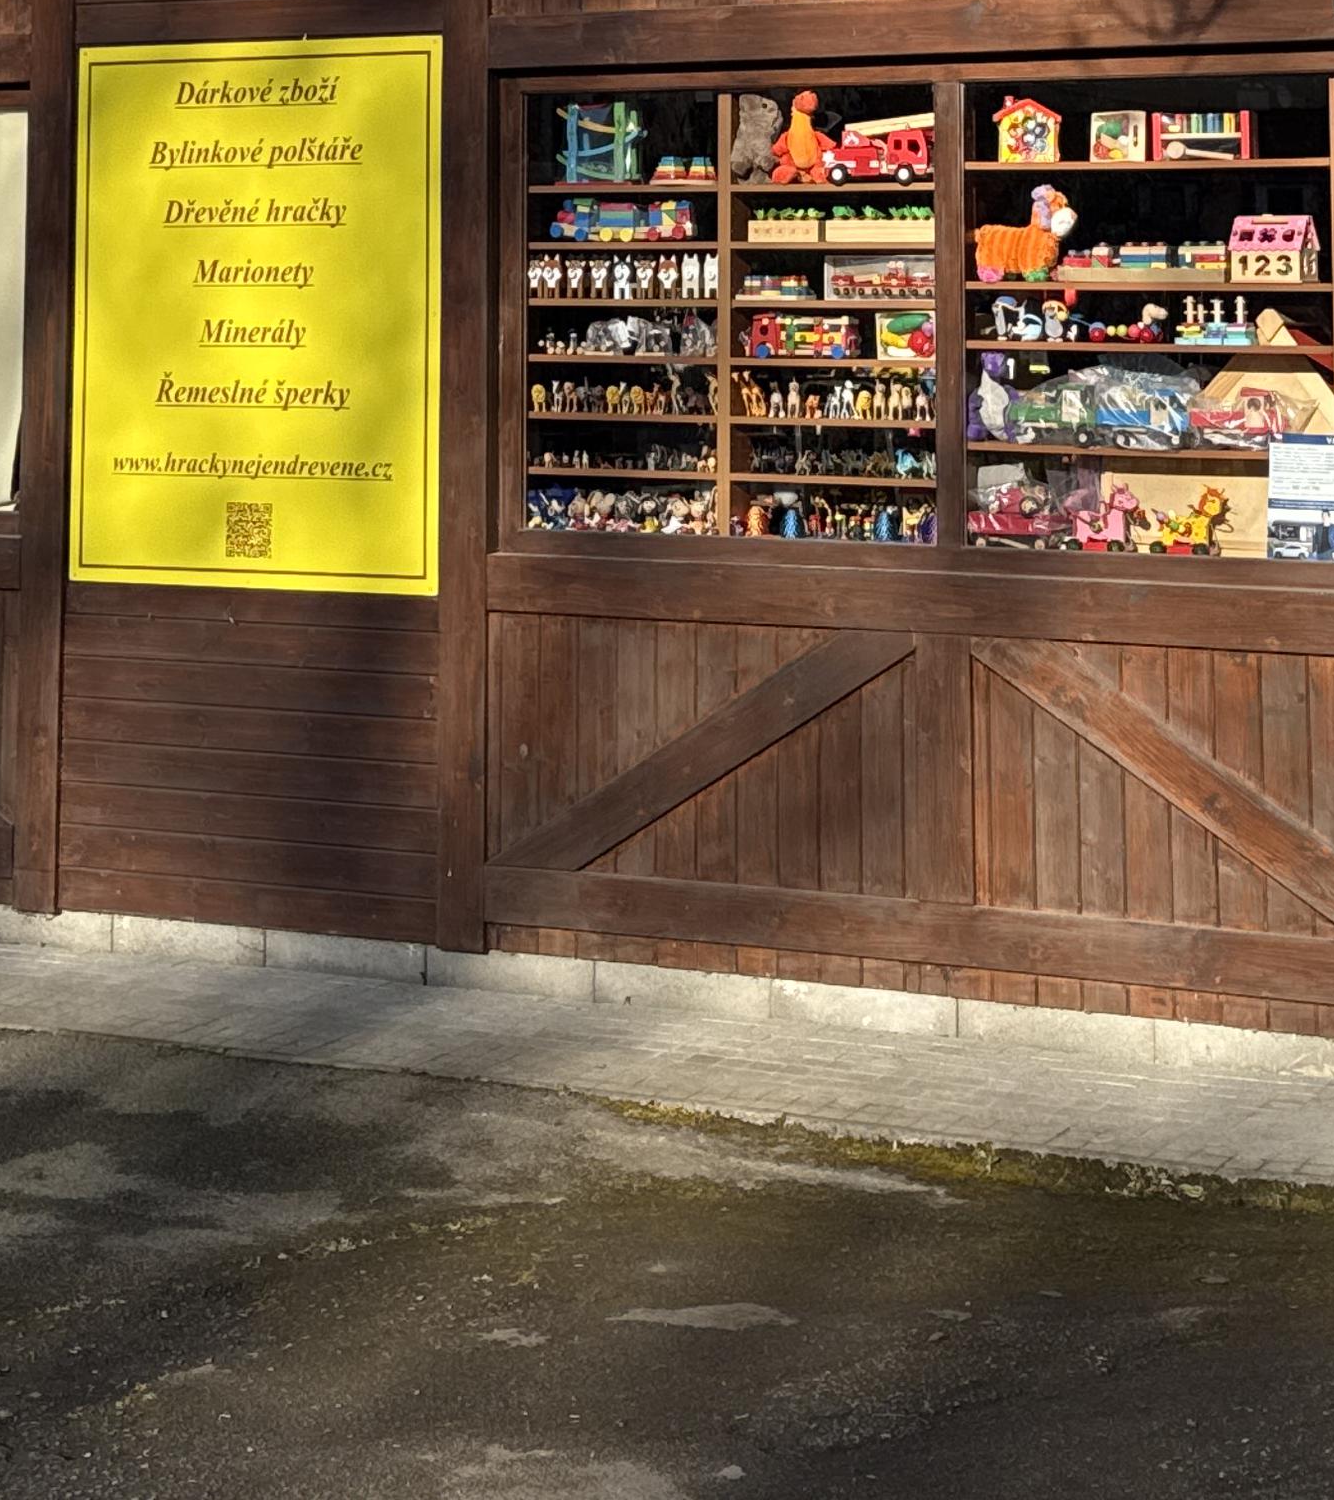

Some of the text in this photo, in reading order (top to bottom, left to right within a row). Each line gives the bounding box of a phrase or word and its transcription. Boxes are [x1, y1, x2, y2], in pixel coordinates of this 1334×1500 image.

[174, 75, 341, 106] Dárkové zboží
[149, 136, 364, 170] Bylinkové polštáře
[164, 197, 347, 228] Dřevěné hračky
[193, 258, 315, 289] Marionety
[199, 318, 307, 350] Minerály
[155, 371, 351, 411] Řemeslné šperky
[112, 451, 394, 481] www.hrackynejendrevene.cz
